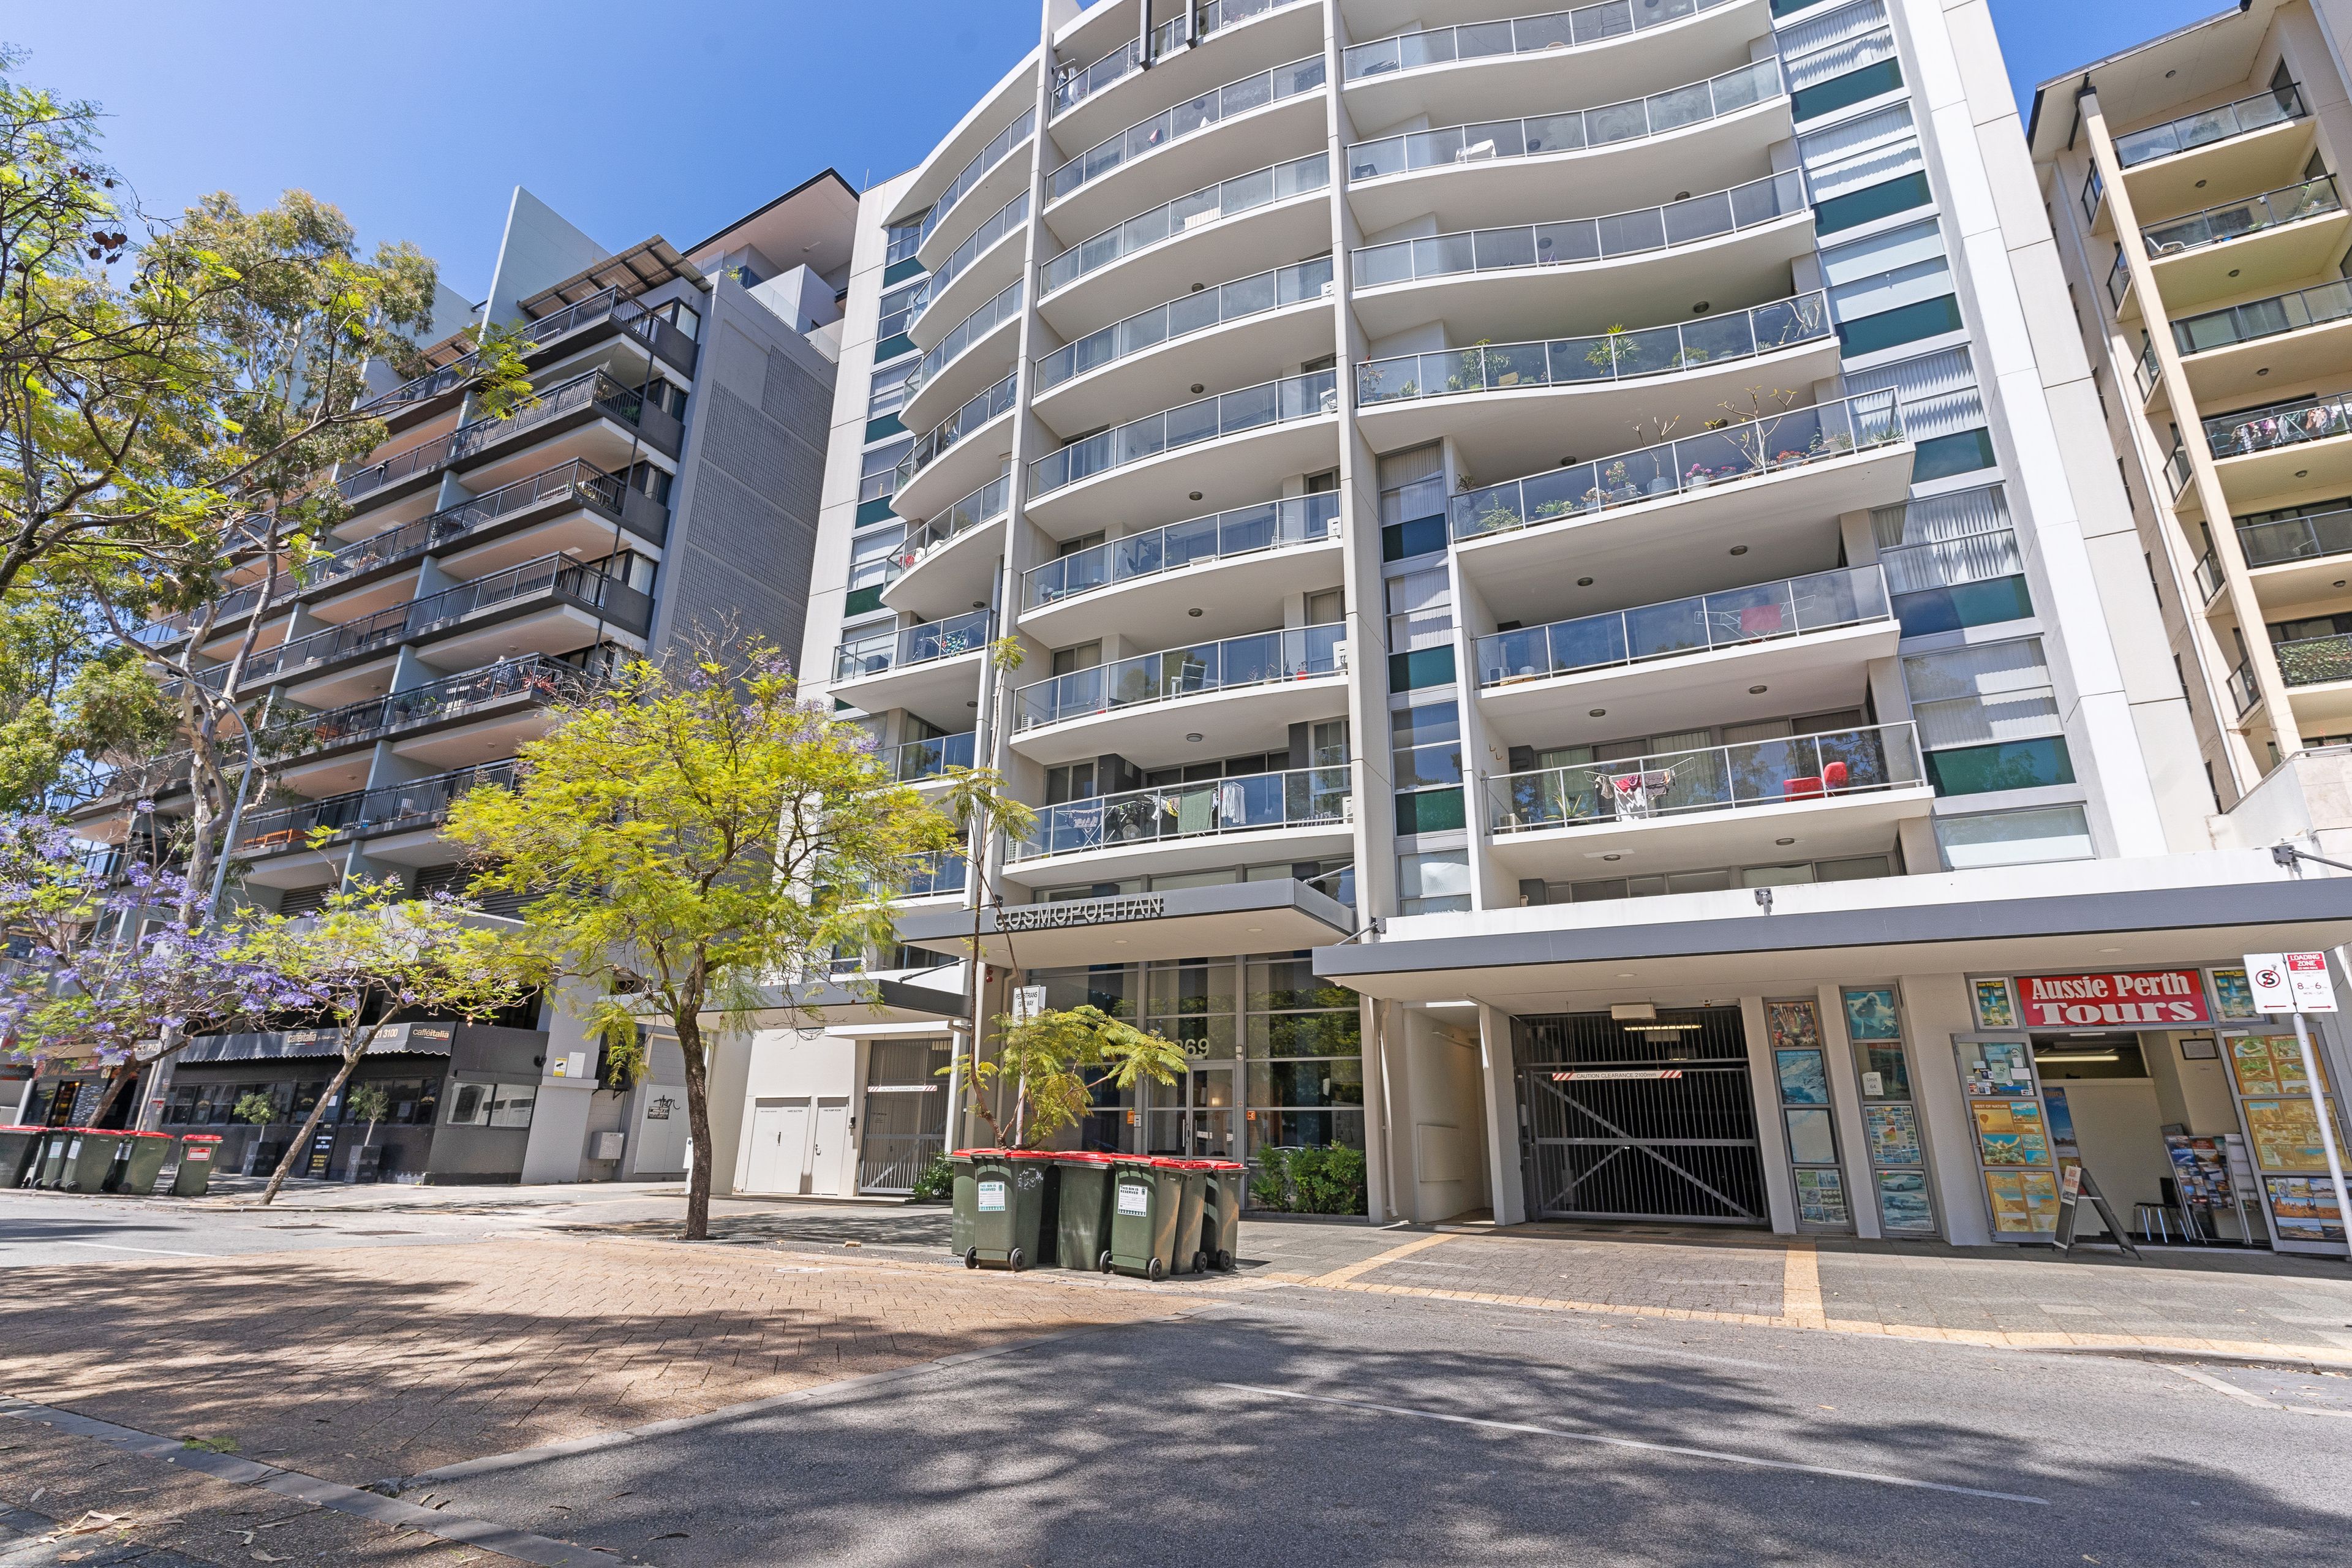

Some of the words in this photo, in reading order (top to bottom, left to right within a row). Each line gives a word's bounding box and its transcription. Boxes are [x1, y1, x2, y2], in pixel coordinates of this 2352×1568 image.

[994, 893, 1161, 929] COSMOPOLITAN
[2032, 976, 2108, 1000] Aussie
[2113, 973, 2192, 997] Perth
[2032, 1001, 2198, 1025] Tours
[383, 1028, 398, 1038] 3100
